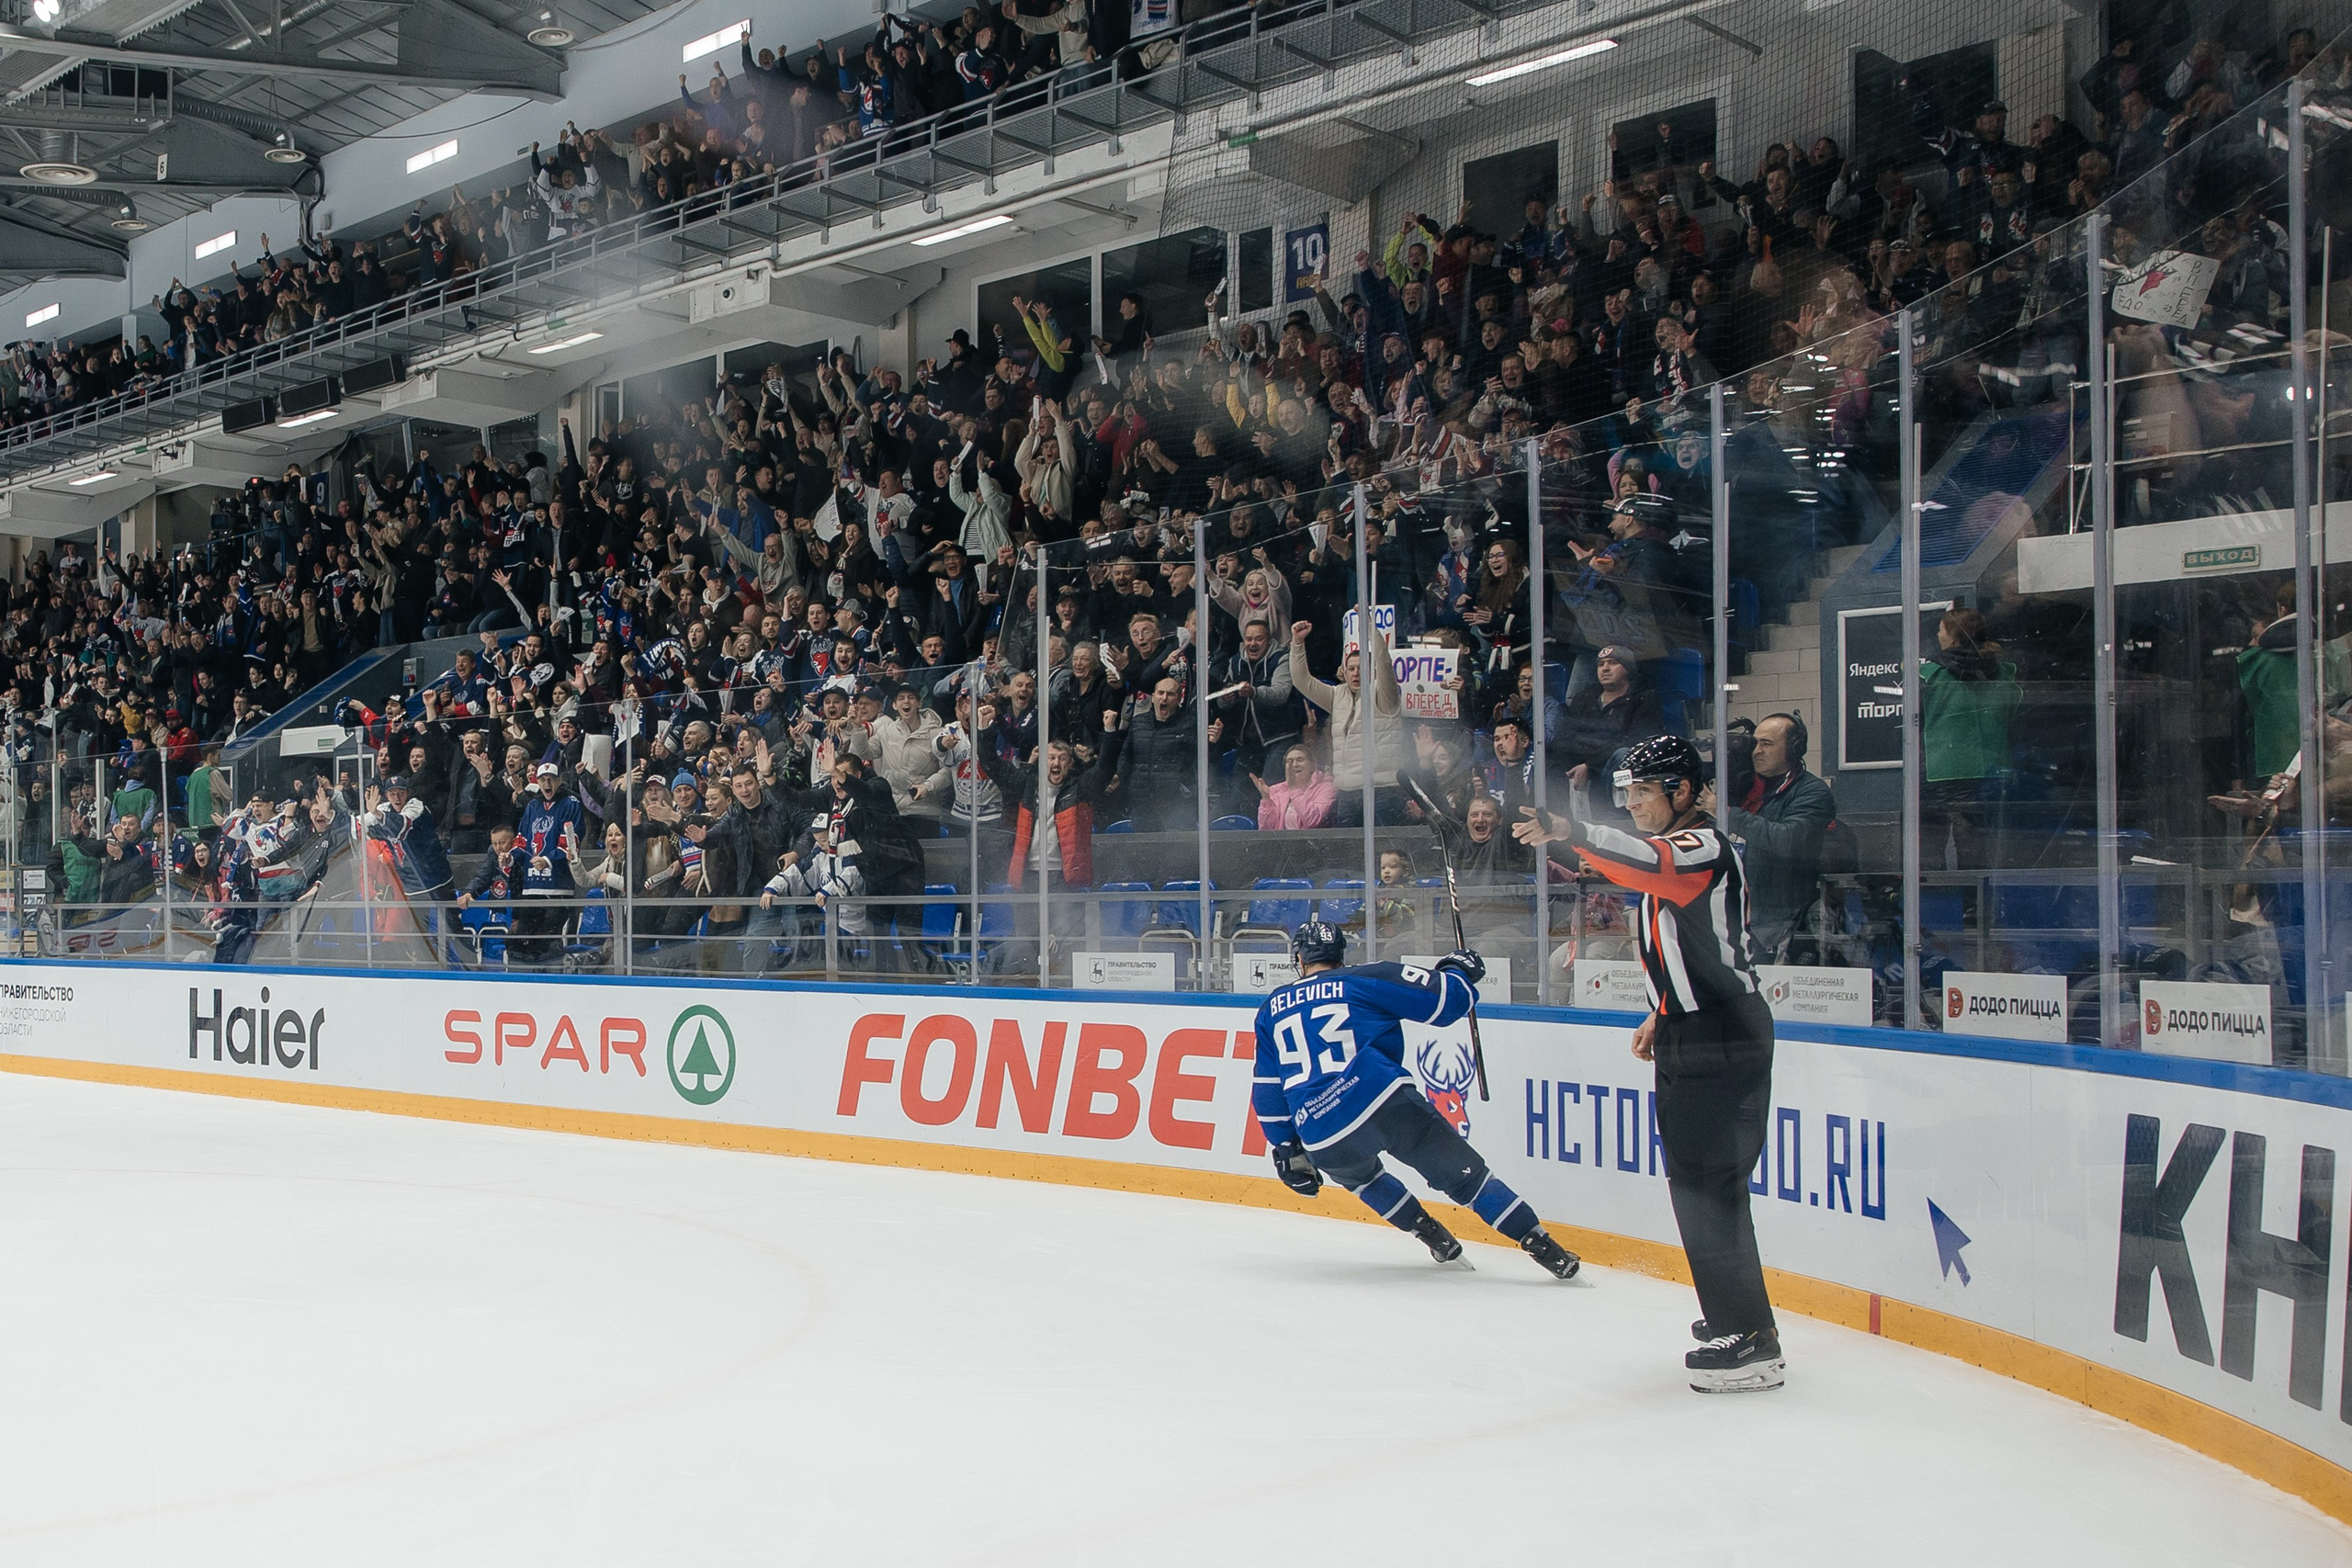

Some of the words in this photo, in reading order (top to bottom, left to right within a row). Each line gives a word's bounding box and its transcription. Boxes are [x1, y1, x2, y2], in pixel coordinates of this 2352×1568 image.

[160, 161, 164, 174] 6
[1292, 233, 1323, 270] 10
[317, 481, 325, 504] 9
[2188, 549, 2254, 564] ВЫХОД
[1393, 656, 1453, 683] ОРПЕ-
[1849, 662, 1899, 678] Яндекс
[1319, 931, 1333, 942] 93
[1792, 976, 1845, 987] ОБЪЕДИНЕННАЯ
[1270, 981, 1344, 1017] BELEVICH
[1792, 989, 1859, 1002] МЕТАЛЛУРГИЧЕСКАЯ
[1792, 1003, 1828, 1013] КОМПАНИЯ
[1969, 995, 2007, 1017] ДОДО
[2009, 998, 2062, 1021] ПИЦЦА
[188, 987, 326, 1071] Haier
[2167, 1010, 2209, 1033] ДОДО
[2211, 1011, 2266, 1038] ПИЦЦА
[444, 1009, 648, 1077] SPAR
[1272, 1002, 1357, 1090] 93
